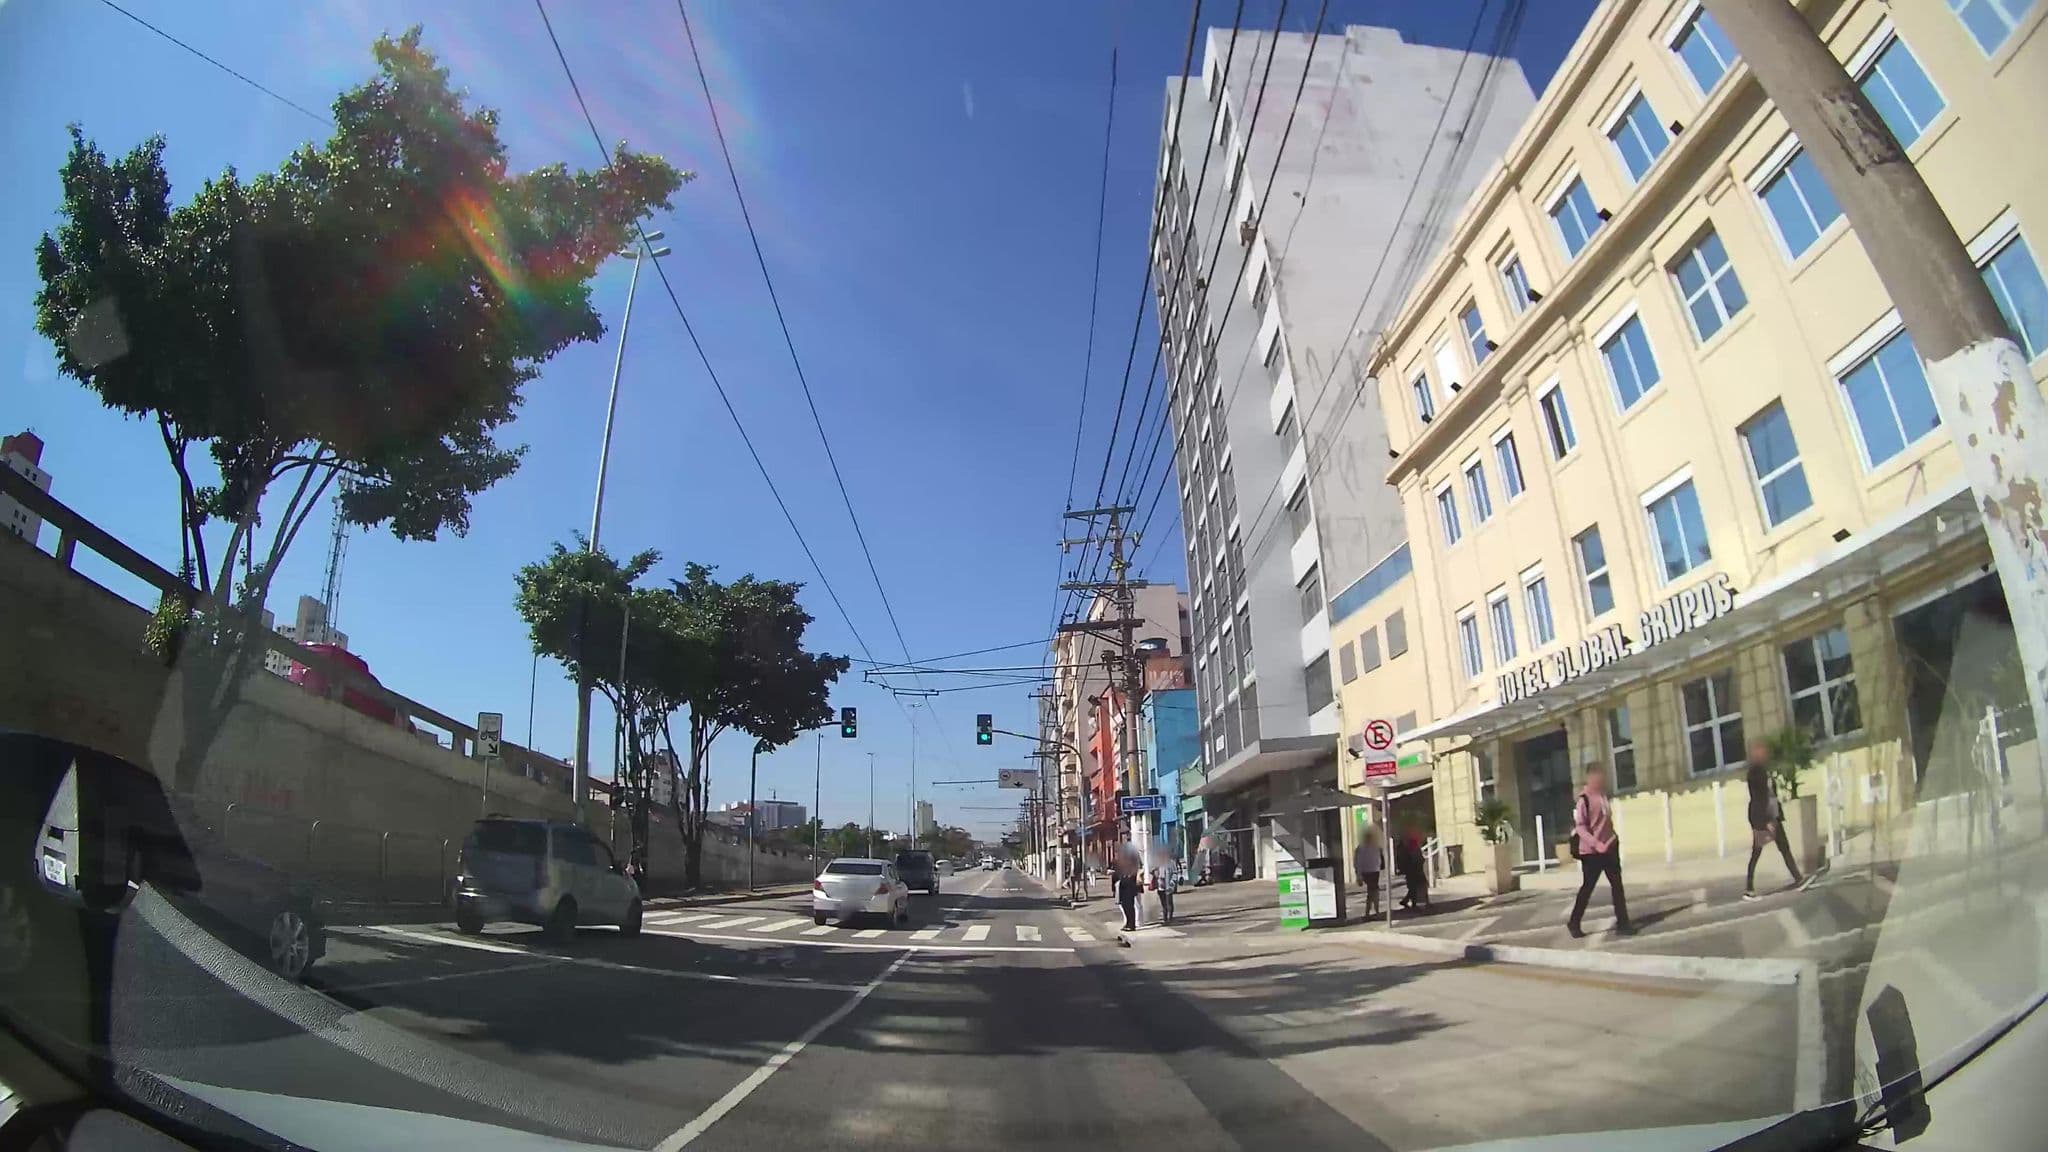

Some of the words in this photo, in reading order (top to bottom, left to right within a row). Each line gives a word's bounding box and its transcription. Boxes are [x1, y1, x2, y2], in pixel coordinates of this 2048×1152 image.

[1496, 658, 1549, 706] HOTEL
[1552, 622, 1632, 683] GLOBAL
[1637, 571, 1736, 648] GRUPOS
[1374, 725, 1387, 744] E
